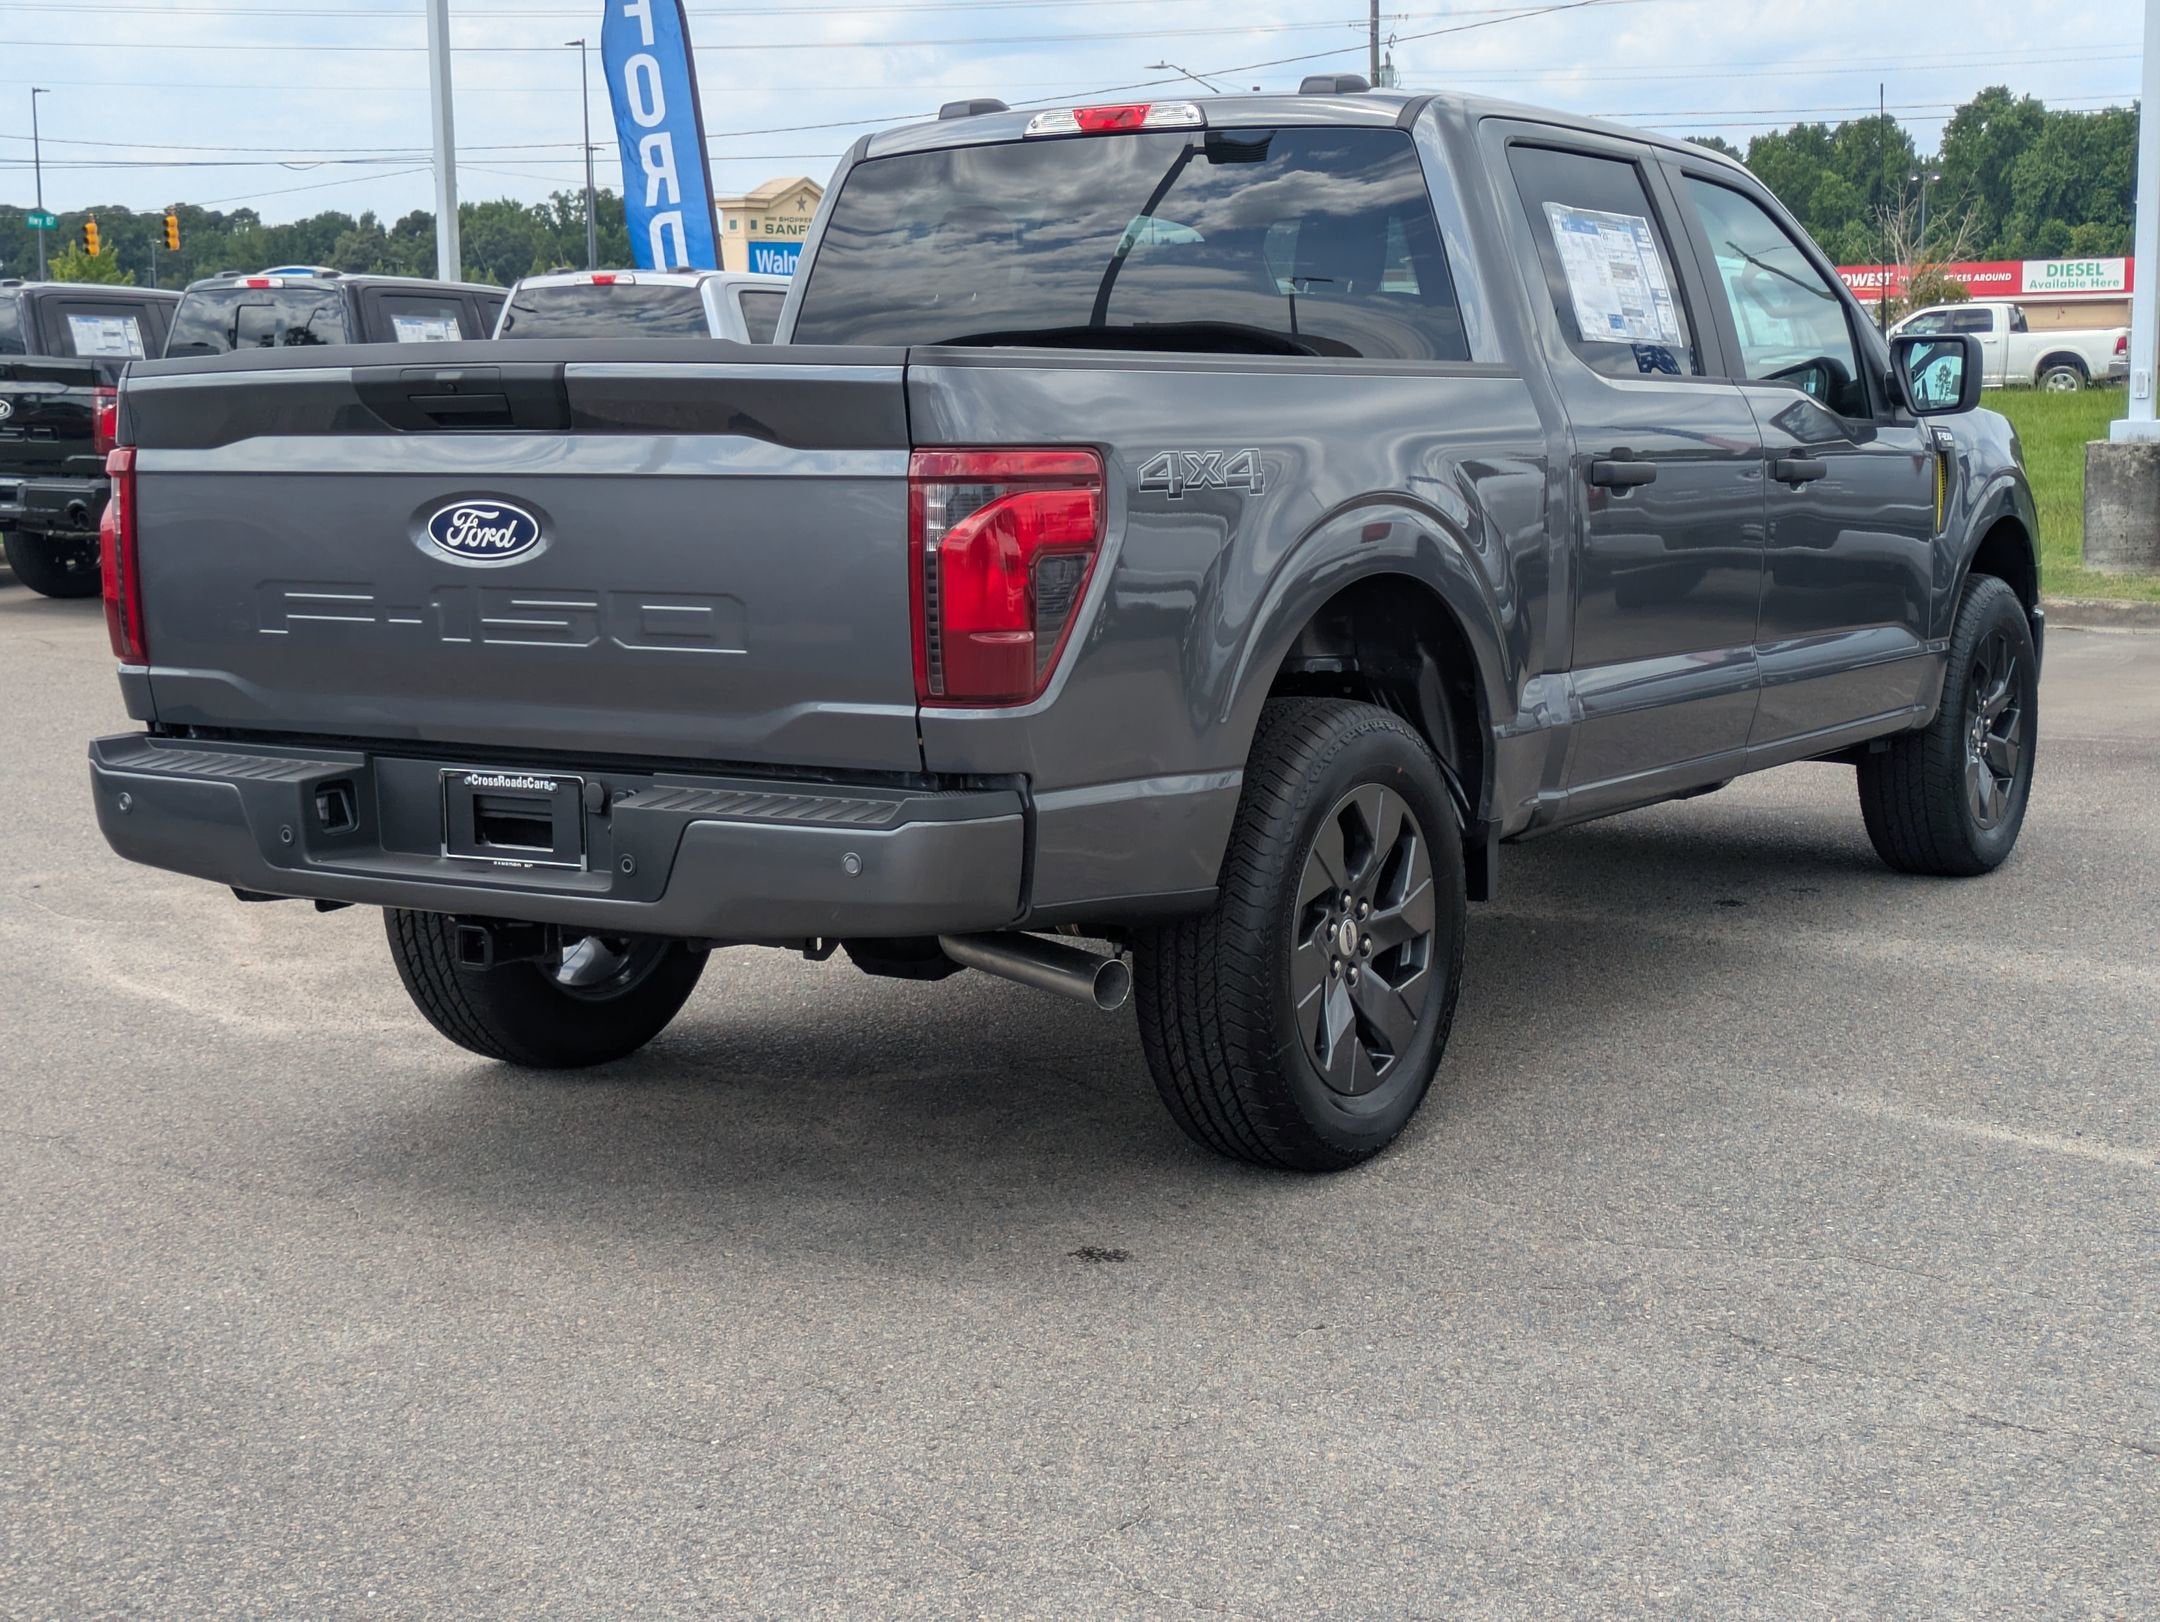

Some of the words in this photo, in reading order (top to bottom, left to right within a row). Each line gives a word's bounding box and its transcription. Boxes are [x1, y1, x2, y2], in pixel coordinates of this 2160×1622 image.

[765, 224, 810, 235] SANF
[2047, 263, 2104, 277] DIESEL
[1840, 272, 1893, 287] OWEST
[1973, 273, 2012, 281] AROUND
[2029, 279, 2086, 289] Available
[2090, 279, 2120, 288] Here
[446, 508, 518, 549] Ford
[256, 579, 748, 654] F-150
[471, 774, 549, 790] CrossRoadsCars
